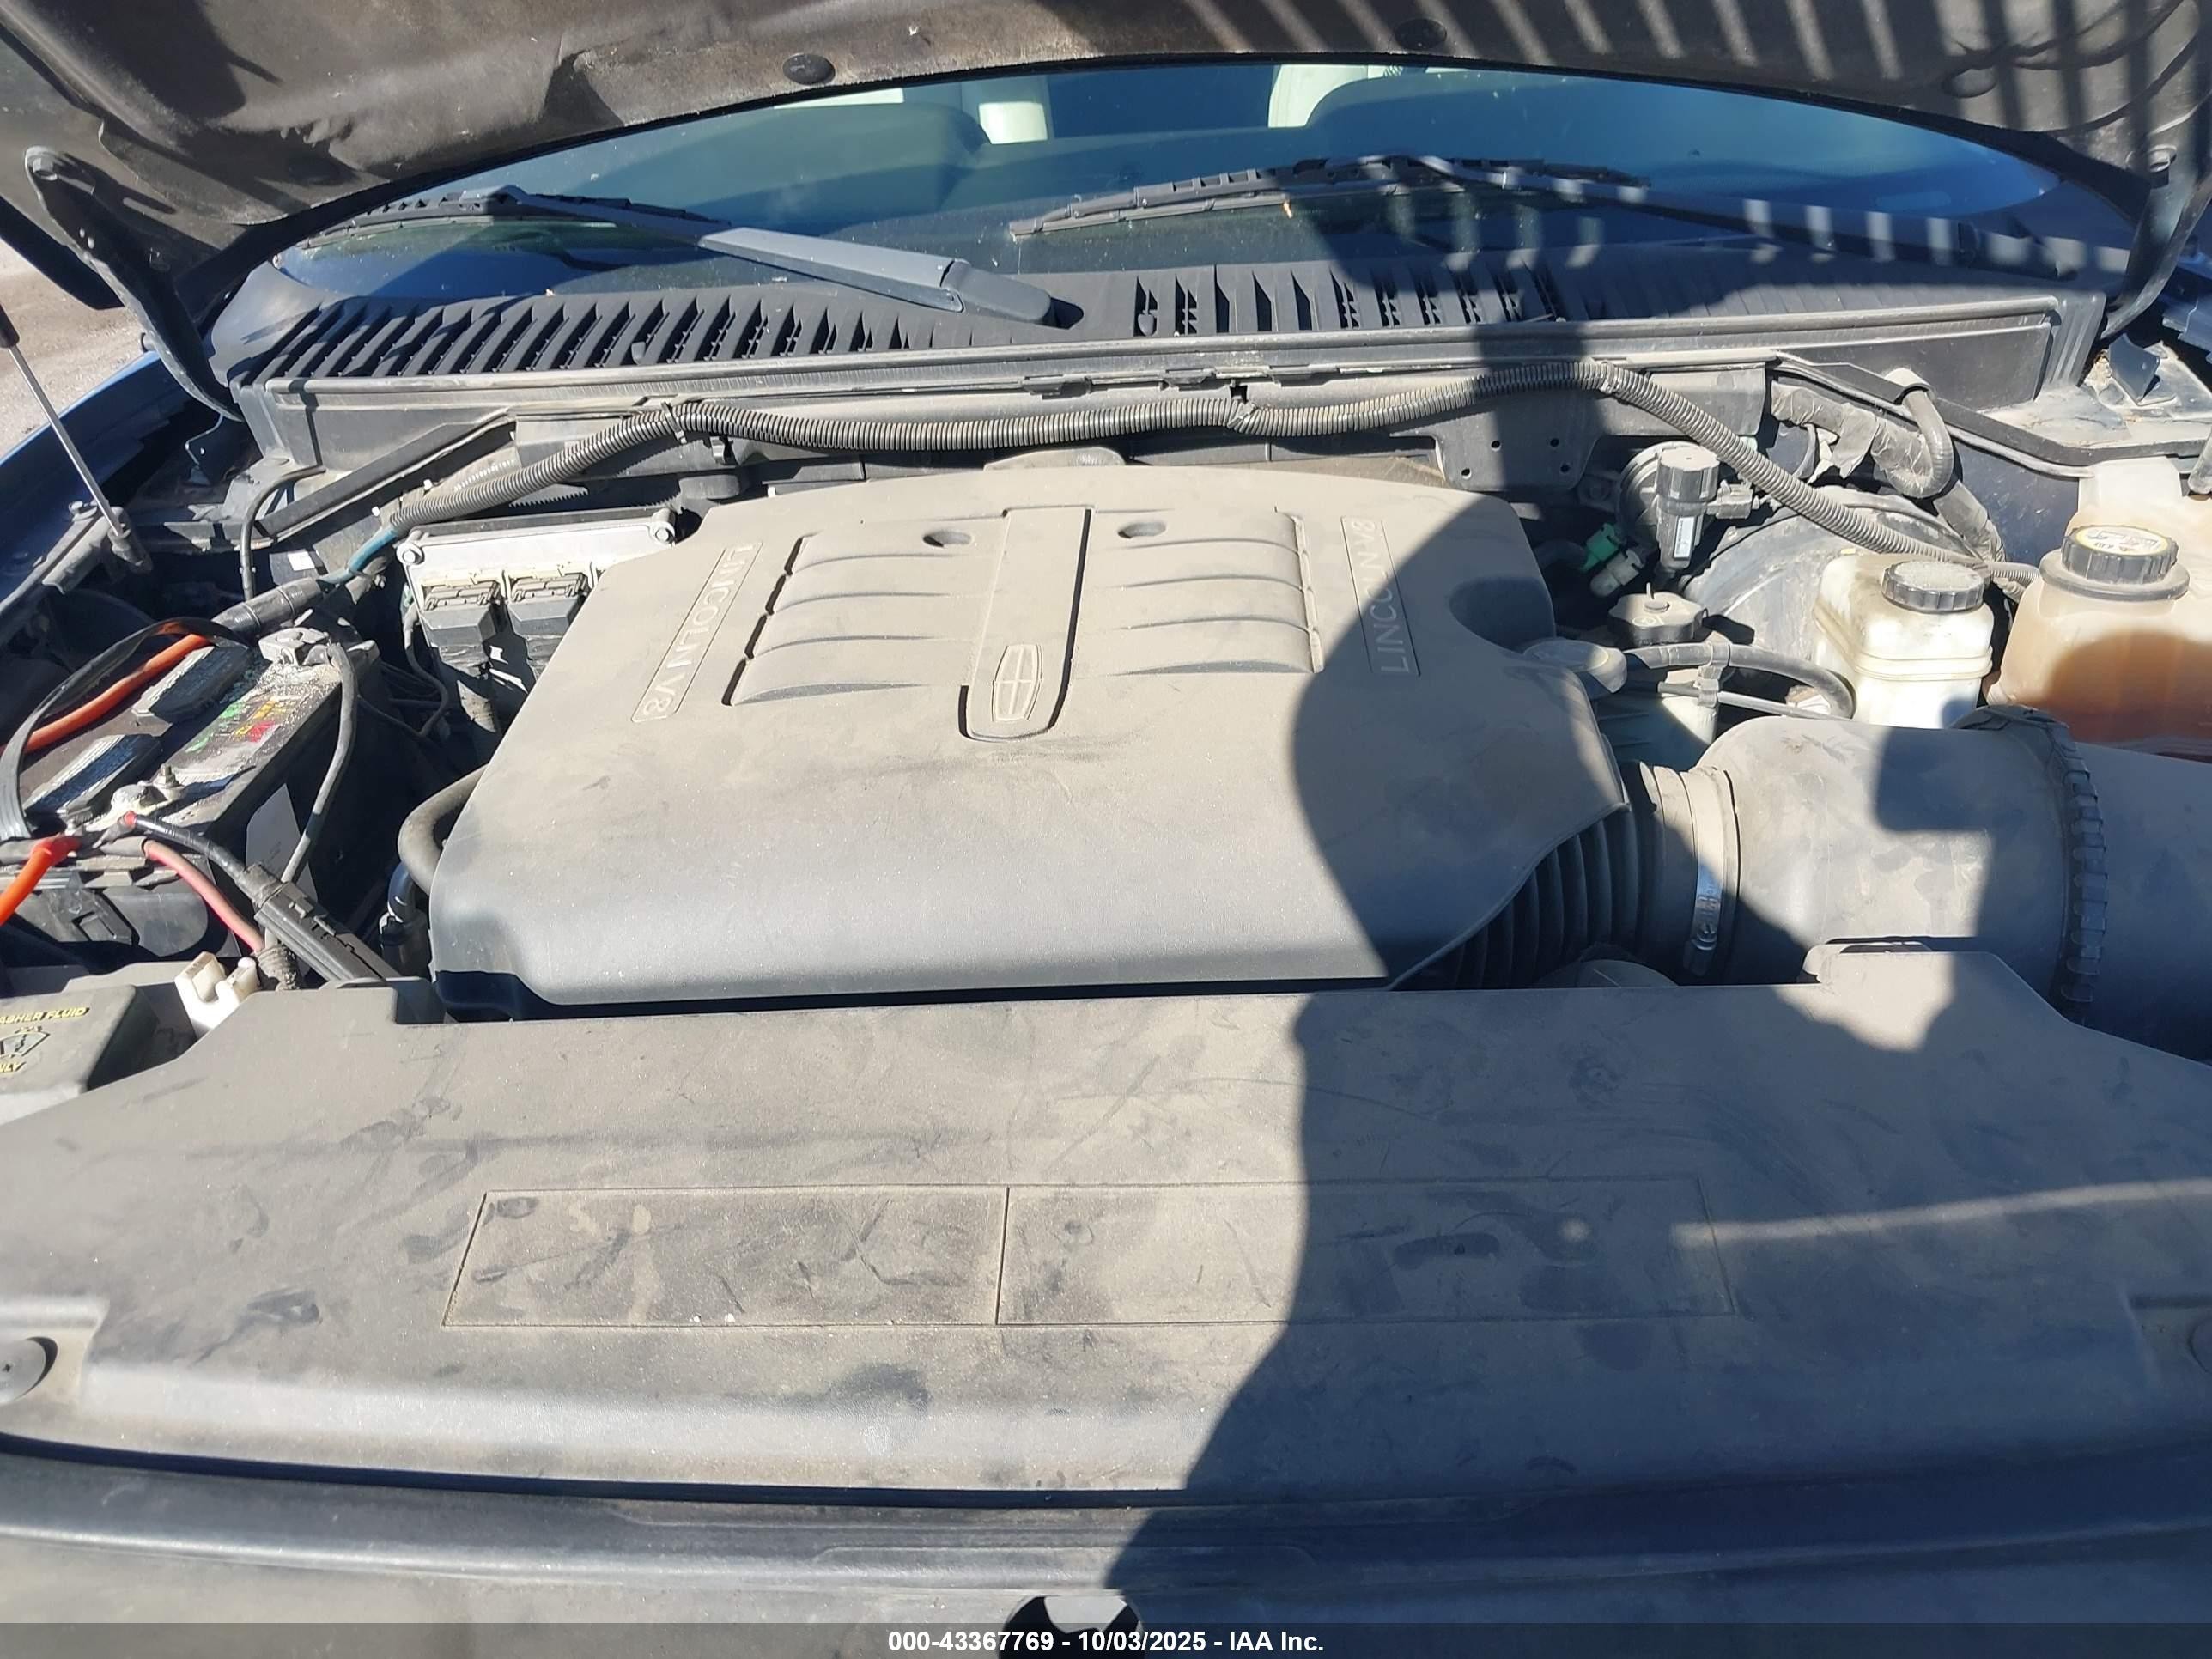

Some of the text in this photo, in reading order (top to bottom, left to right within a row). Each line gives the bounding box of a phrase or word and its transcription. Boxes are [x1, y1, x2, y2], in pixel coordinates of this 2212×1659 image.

[641, 544, 754, 716] LINCOLN V8
[1351, 519, 1410, 673] LINCOLN V8
[46, 1006, 87, 1019] FLUID
